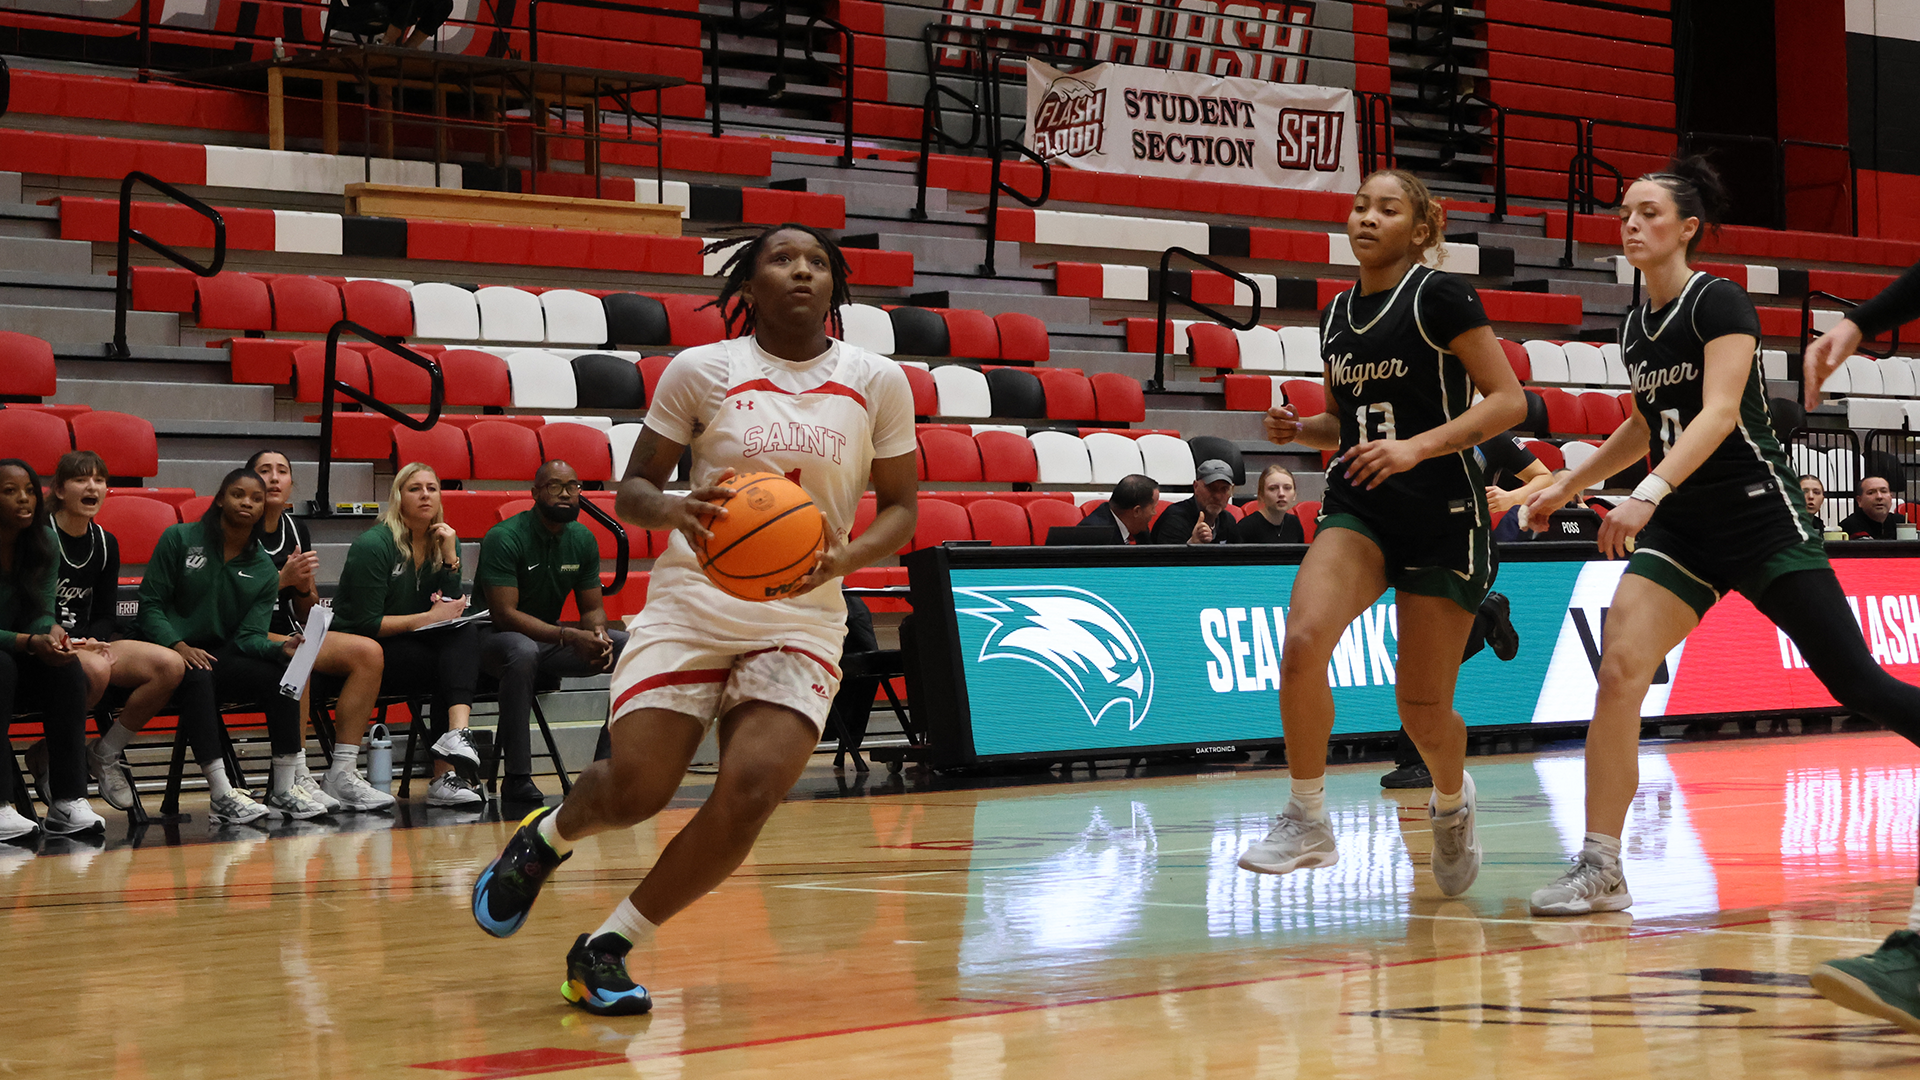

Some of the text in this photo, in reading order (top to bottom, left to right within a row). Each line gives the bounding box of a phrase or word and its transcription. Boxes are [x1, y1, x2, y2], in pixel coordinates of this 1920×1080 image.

[1037, 92, 1103, 128] FLASH
[1124, 88, 1256, 129] STUDENT
[1034, 122, 1101, 157] FLOOD
[1132, 130, 1256, 169] SECTION
[1279, 110, 1342, 171] SFU
[1329, 353, 1409, 398] Wagner
[1629, 359, 1699, 404] Wagner
[743, 421, 847, 466] SAINT
[1355, 401, 1397, 446] 13
